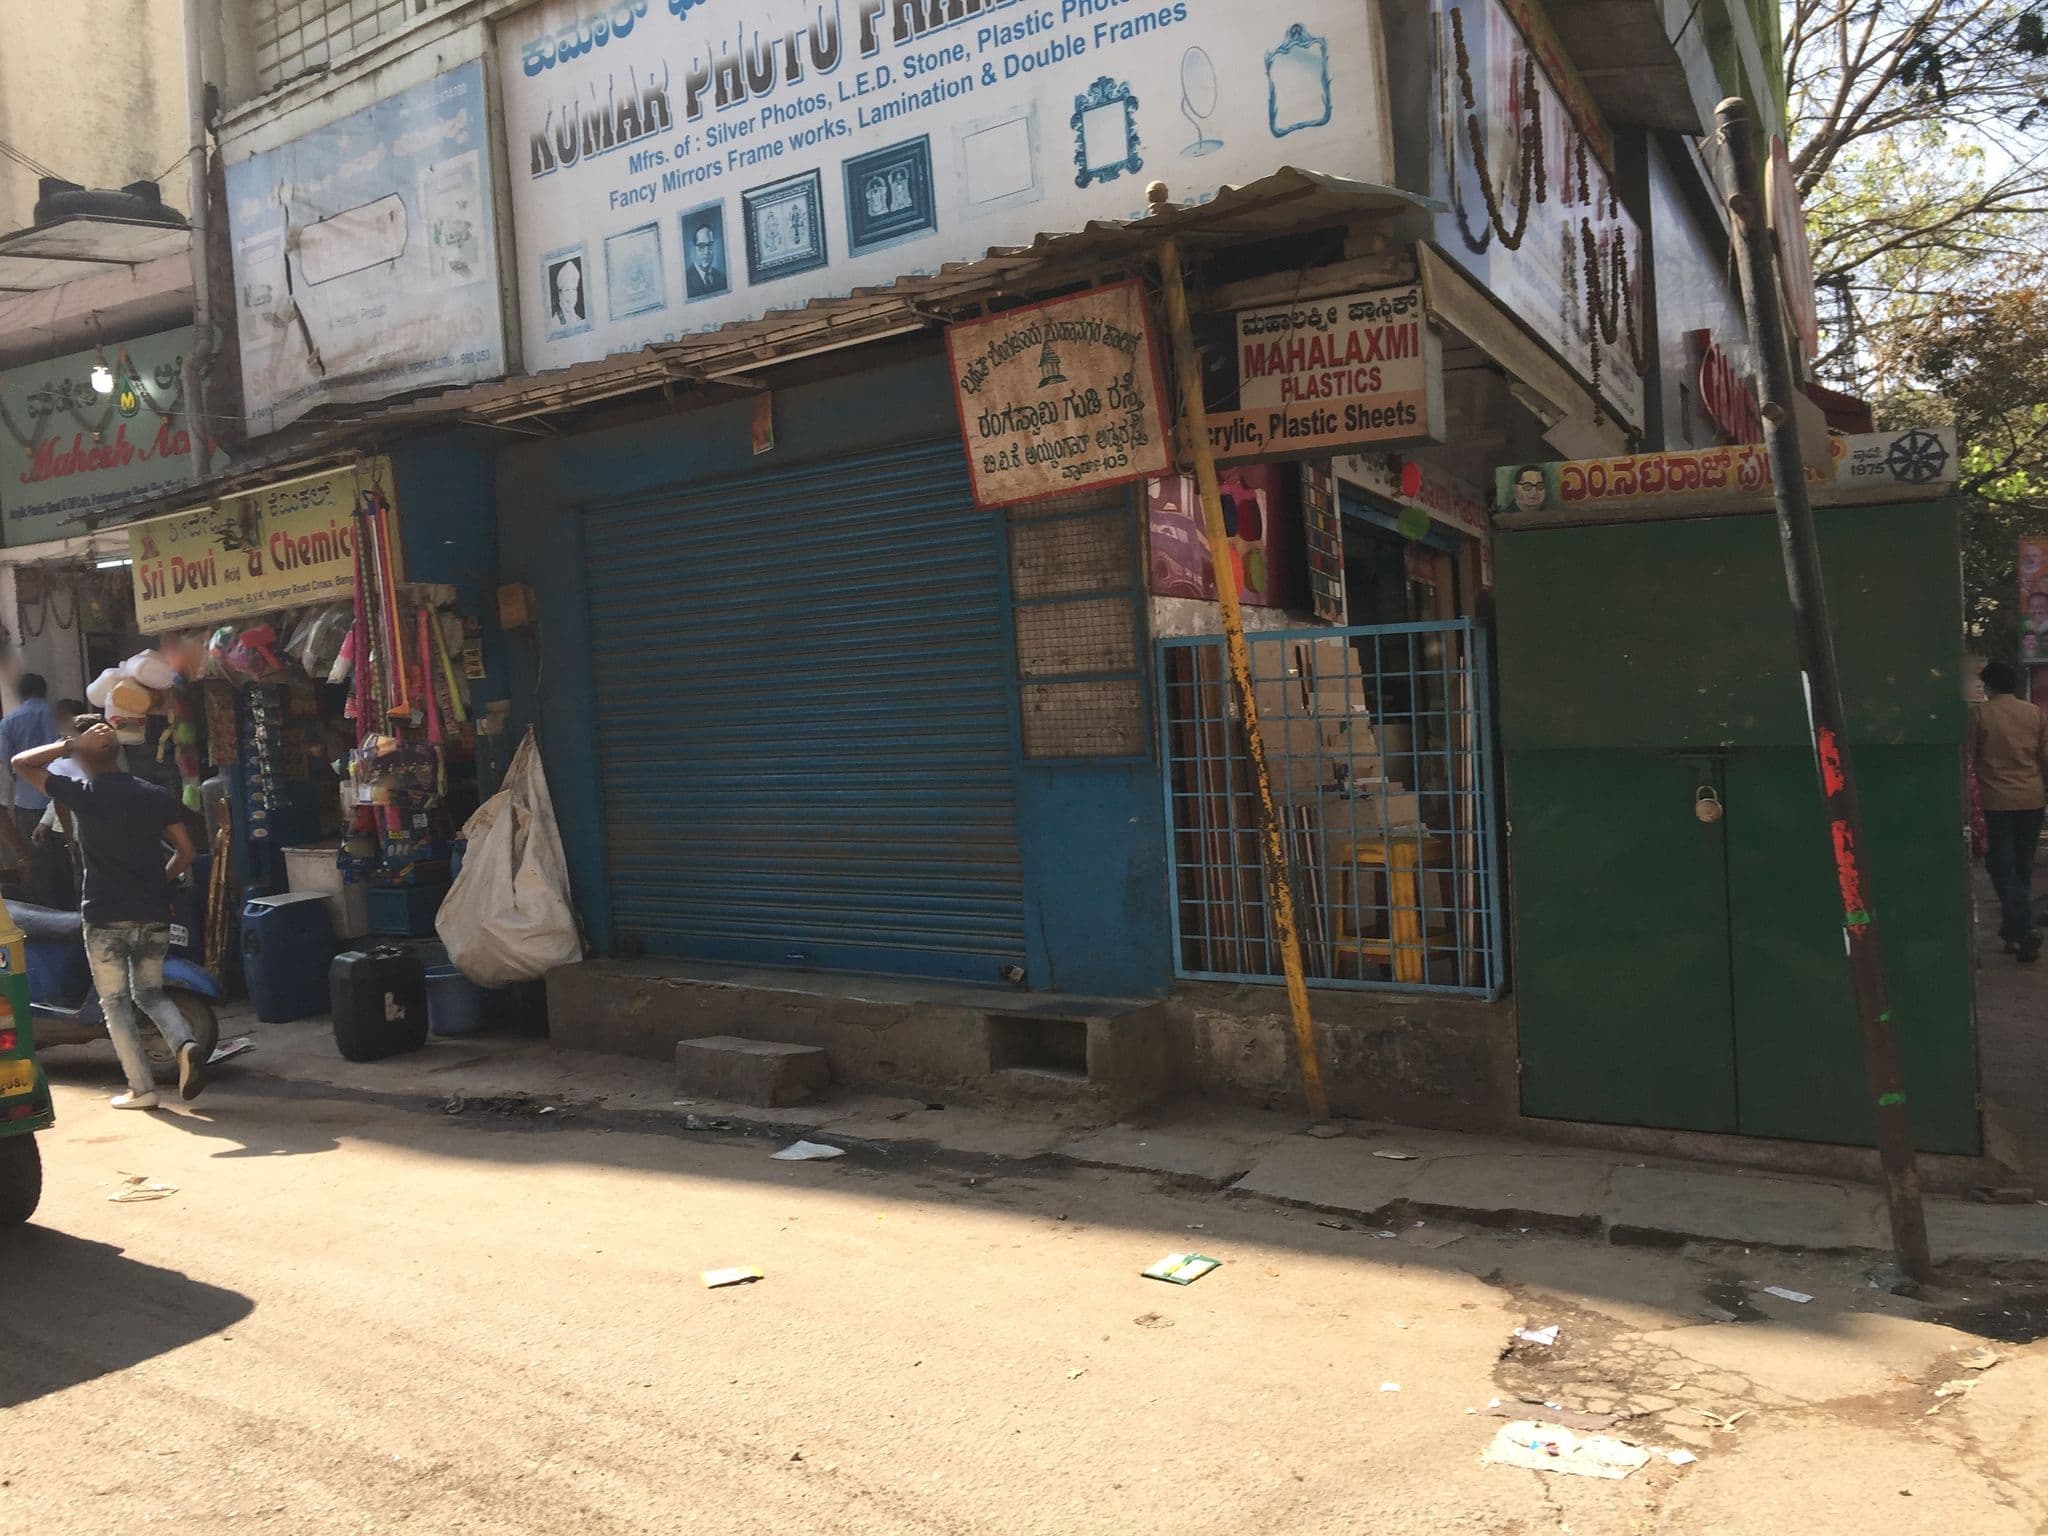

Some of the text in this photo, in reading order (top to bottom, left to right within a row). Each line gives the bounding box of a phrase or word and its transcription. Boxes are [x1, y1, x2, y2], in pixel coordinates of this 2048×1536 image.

[530, 57, 673, 180] KUMAR
[686, 0, 842, 122] PHOTO
[609, 2, 1188, 211] Fancy Mirrors Frame works, Lamination & Double Frames
[628, 148, 671, 176] Mfrs.
[674, 137, 691, 160] of
[706, 117, 756, 148] Silver
[761, 91, 832, 129] Photos,
[838, 65, 897, 103] L.E.D.
[903, 43, 971, 79] Stone,
[977, 8, 1054, 53] Plastic
[1243, 321, 1419, 379] MAHALAXMI
[1280, 366, 1382, 402] PLASTICS
[1269, 408, 1338, 440] Plastic
[1344, 400, 1417, 432] Sheets
[140, 561, 166, 601] Sri
[171, 547, 217, 595] Devi
[270, 519, 357, 573] Chemic
